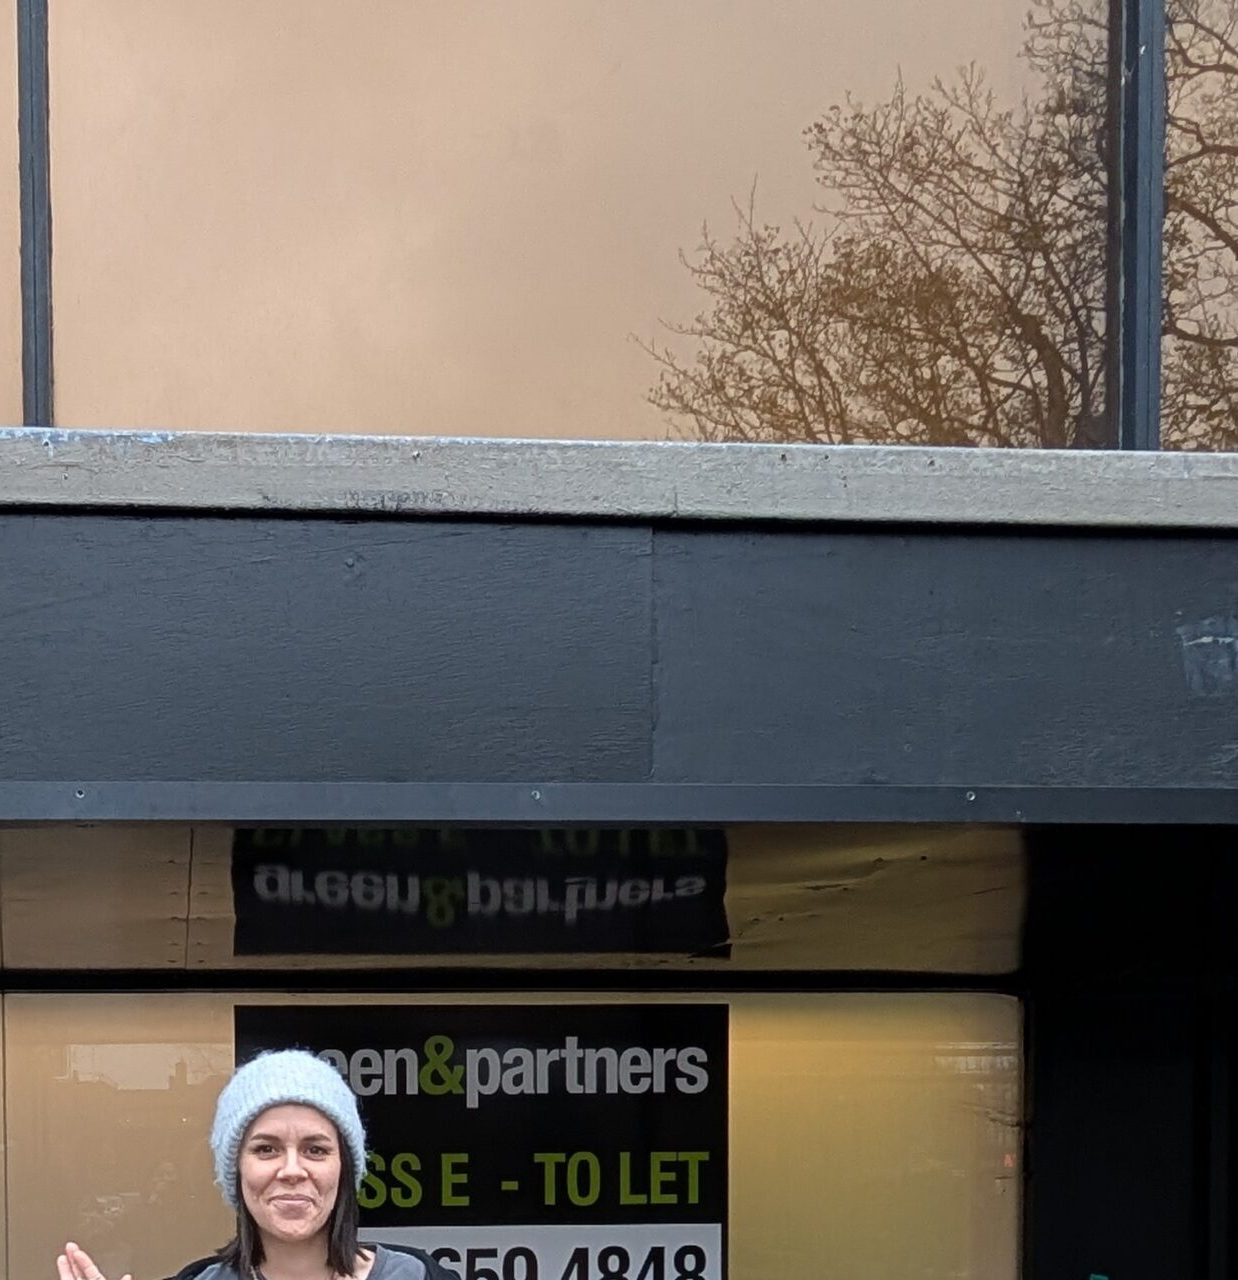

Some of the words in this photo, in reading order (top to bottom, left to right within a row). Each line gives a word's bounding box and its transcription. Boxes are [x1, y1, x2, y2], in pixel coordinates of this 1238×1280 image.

[317, 1035, 708, 1108] een&partners
[358, 1152, 422, 1208] SS
[442, 1153, 469, 1206] E
[533, 1152, 601, 1206] TO
[619, 1151, 709, 1205] LET
